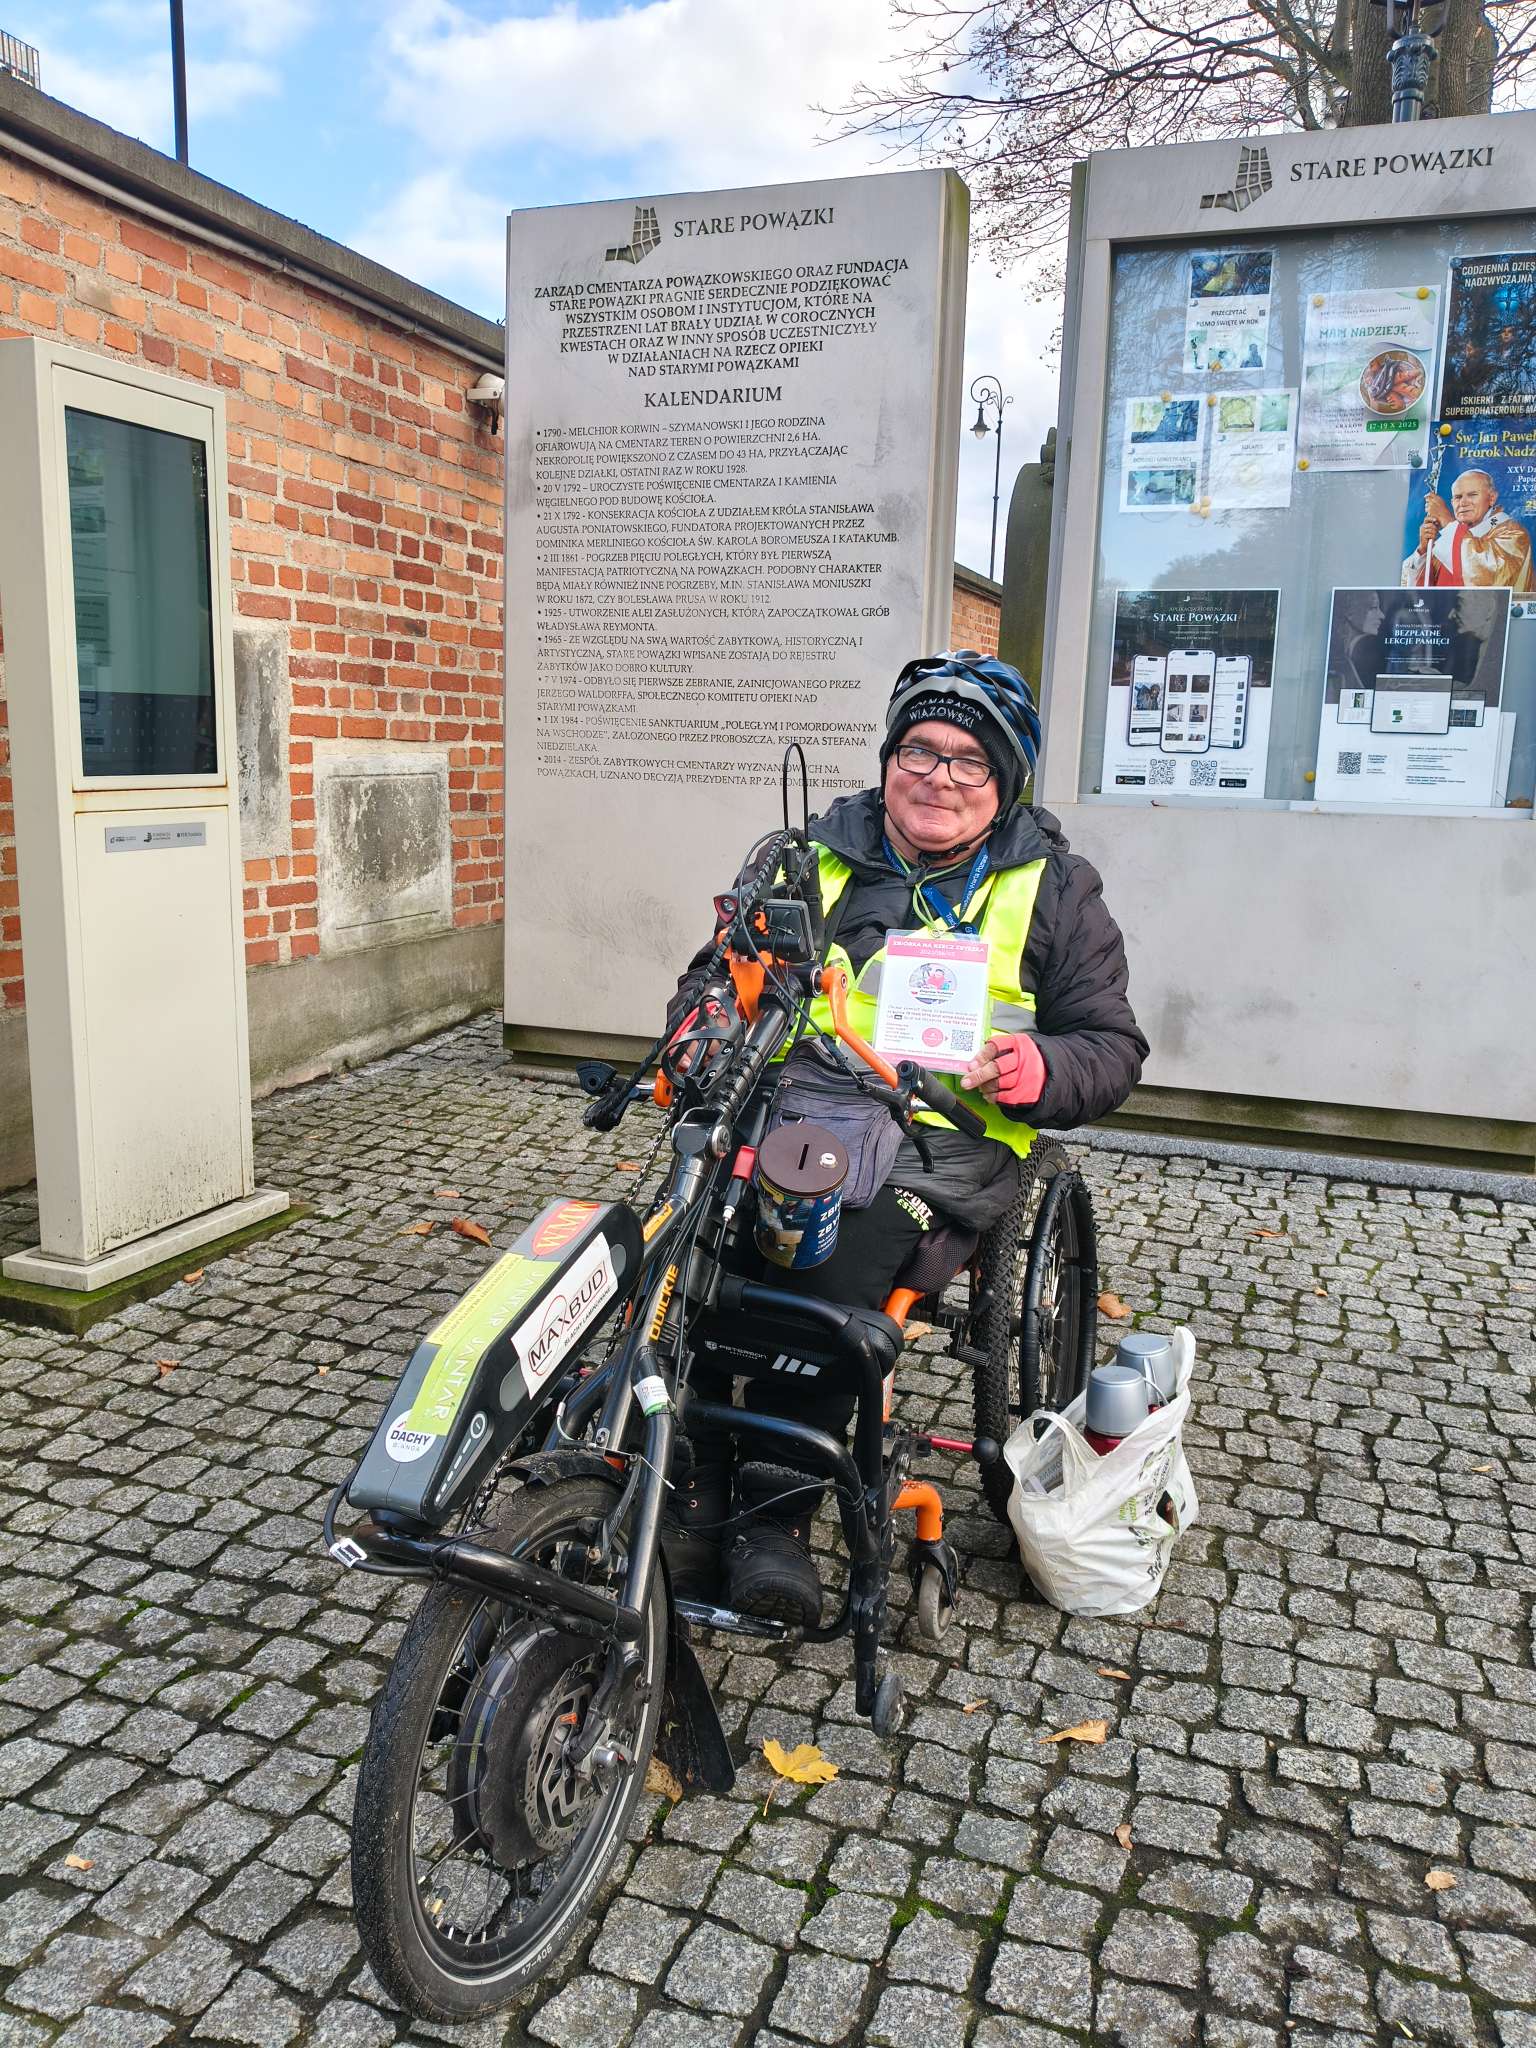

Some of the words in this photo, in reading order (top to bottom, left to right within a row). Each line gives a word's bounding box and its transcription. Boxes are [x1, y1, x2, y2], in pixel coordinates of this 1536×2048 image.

[1290, 158, 1366, 182] STARE
[1374, 147, 1494, 175] POWĄZKI
[674, 216, 735, 238] STARE
[741, 208, 833, 236] POWĄZKI
[535, 283, 584, 301] ZARZĄD
[586, 277, 662, 294] CMENTARZA
[666, 268, 792, 291] POWĄZKOWSKIEGO
[796, 264, 833, 279] ORAZ
[837, 259, 908, 278] FUNDACJA
[1462, 264, 1510, 276] CODZIENNA
[1464, 274, 1533, 288] NADZWYCZAJNA
[549, 297, 586, 312] STARE
[589, 293, 646, 311] POWĄZKI
[649, 289, 705, 304] PRAGNIE
[708, 283, 788, 300] SERDECZNIE
[791, 272, 891, 297] PODZIĘKOWAĆ
[566, 308, 637, 325] WSZYSTKIM
[640, 304, 695, 320] OSOBOM
[699, 304, 703, 316] I
[707, 297, 801, 317] INSTYTUCJOM,
[804, 291, 849, 308] KTÓRE
[853, 292, 872, 305] NA
[563, 322, 641, 339] PRZESTRZENI
[645, 320, 665, 333] LAT
[671, 317, 711, 332] BRAŁY
[715, 314, 762, 329] UDZIAŁ
[766, 313, 778, 326] W
[781, 307, 875, 325] COROCZNYCH
[560, 337, 626, 353] KWESTACH
[629, 335, 664, 348] ORAZ
[667, 334, 678, 346] W
[681, 332, 713, 345] INNY
[716, 325, 766, 343] SPOSÓB
[770, 322, 877, 340] UCZESTNICZYŁY
[608, 352, 618, 365] W
[622, 347, 710, 364] DZIAŁANIACH
[713, 346, 731, 358] NA
[736, 343, 776, 357] RZECZ
[779, 340, 823, 355] OPIEKI
[628, 365, 656, 378] NAD
[659, 361, 714, 376] STARYMI
[717, 357, 799, 376] POWĄZKAMI
[645, 386, 782, 407] KALENDARIUM
[1461, 395, 1494, 405] ISKIERKI
[1445, 406, 1524, 416] SUPERBOHATEROWIE
[544, 427, 562, 437] 1790
[568, 425, 618, 436] MELCHIOR
[620, 423, 660, 434] KORWIN
[669, 420, 743, 432] SZYMANOWSKI
[751, 419, 776, 430] JEGO
[777, 417, 825, 428] RODZINA
[1456, 429, 1474, 443] Św.
[1479, 431, 1498, 444] Jan
[535, 440, 596, 453] OFIAROWUJĄ
[598, 439, 613, 449] NA
[615, 437, 668, 449] CMENTARZ
[672, 436, 702, 447] TEREN
[703, 436, 712, 445] O
[714, 433, 785, 445] POWIERZCHNI
[787, 433, 800, 444] 2,6
[802, 432, 820, 442] HA.
[1459, 446, 1501, 458] Prorok
[536, 454, 594, 467] NEKROPOLIĘ
[596, 452, 667, 465] POWIĘKSZONO
[668, 451, 675, 461] Z
[676, 450, 717, 461] CZASEM
[719, 449, 735, 459] DO
[736, 449, 746, 459] 43
[749, 448, 766, 460] HA,
[769, 446, 848, 460] PRZYŁĄCZAJĄC
[536, 468, 576, 480] KOLEJNE
[578, 467, 618, 479] DZIAŁKI,
[620, 466, 660, 477] OSTATNI
[662, 466, 682, 476] RAZ
[684, 466, 694, 475] W
[696, 465, 724, 475] ROKU
[727, 464, 747, 474] 1928.
[543, 483, 553, 493] 20
[564, 483, 581, 492] 1792
[590, 481, 644, 492] UROCZYSTE
[646, 477, 712, 492] POŚWIĘCENIE
[713, 477, 776, 488] CMENTARZA
[784, 476, 837, 486] KAMIENIA
[537, 524, 579, 534] AUGUSTA
[582, 522, 668, 535] PONIATOWSKIEGO,
[671, 521, 732, 532] FUNDATORA
[734, 519, 830, 532] PROJEKTOWANYCH
[832, 519, 865, 528] PRZEZ
[1153, 613, 1186, 622] STARE
[1188, 613, 1237, 623] POWĄZKI
[649, 1264, 679, 1340] QUICKIE
[530, 1269, 603, 1367] MAXBUD
[390, 1430, 430, 1445] DACHY
